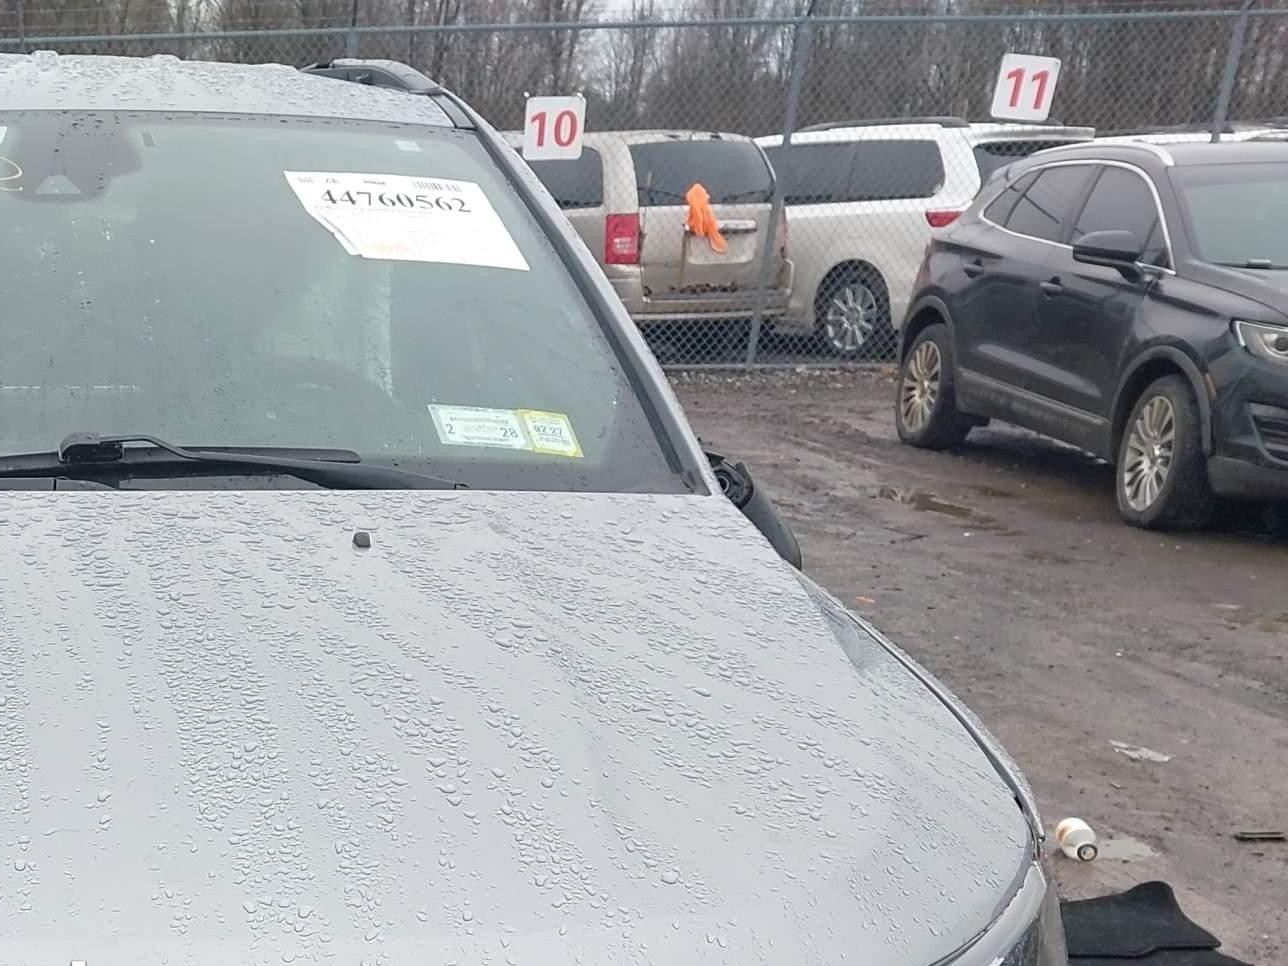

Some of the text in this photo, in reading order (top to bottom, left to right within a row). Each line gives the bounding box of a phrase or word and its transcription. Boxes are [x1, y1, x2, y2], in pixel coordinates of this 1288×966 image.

[1007, 67, 1050, 110] 11
[530, 110, 578, 147] 10
[320, 188, 472, 213] 44760562
[445, 423, 519, 439] 2 28
